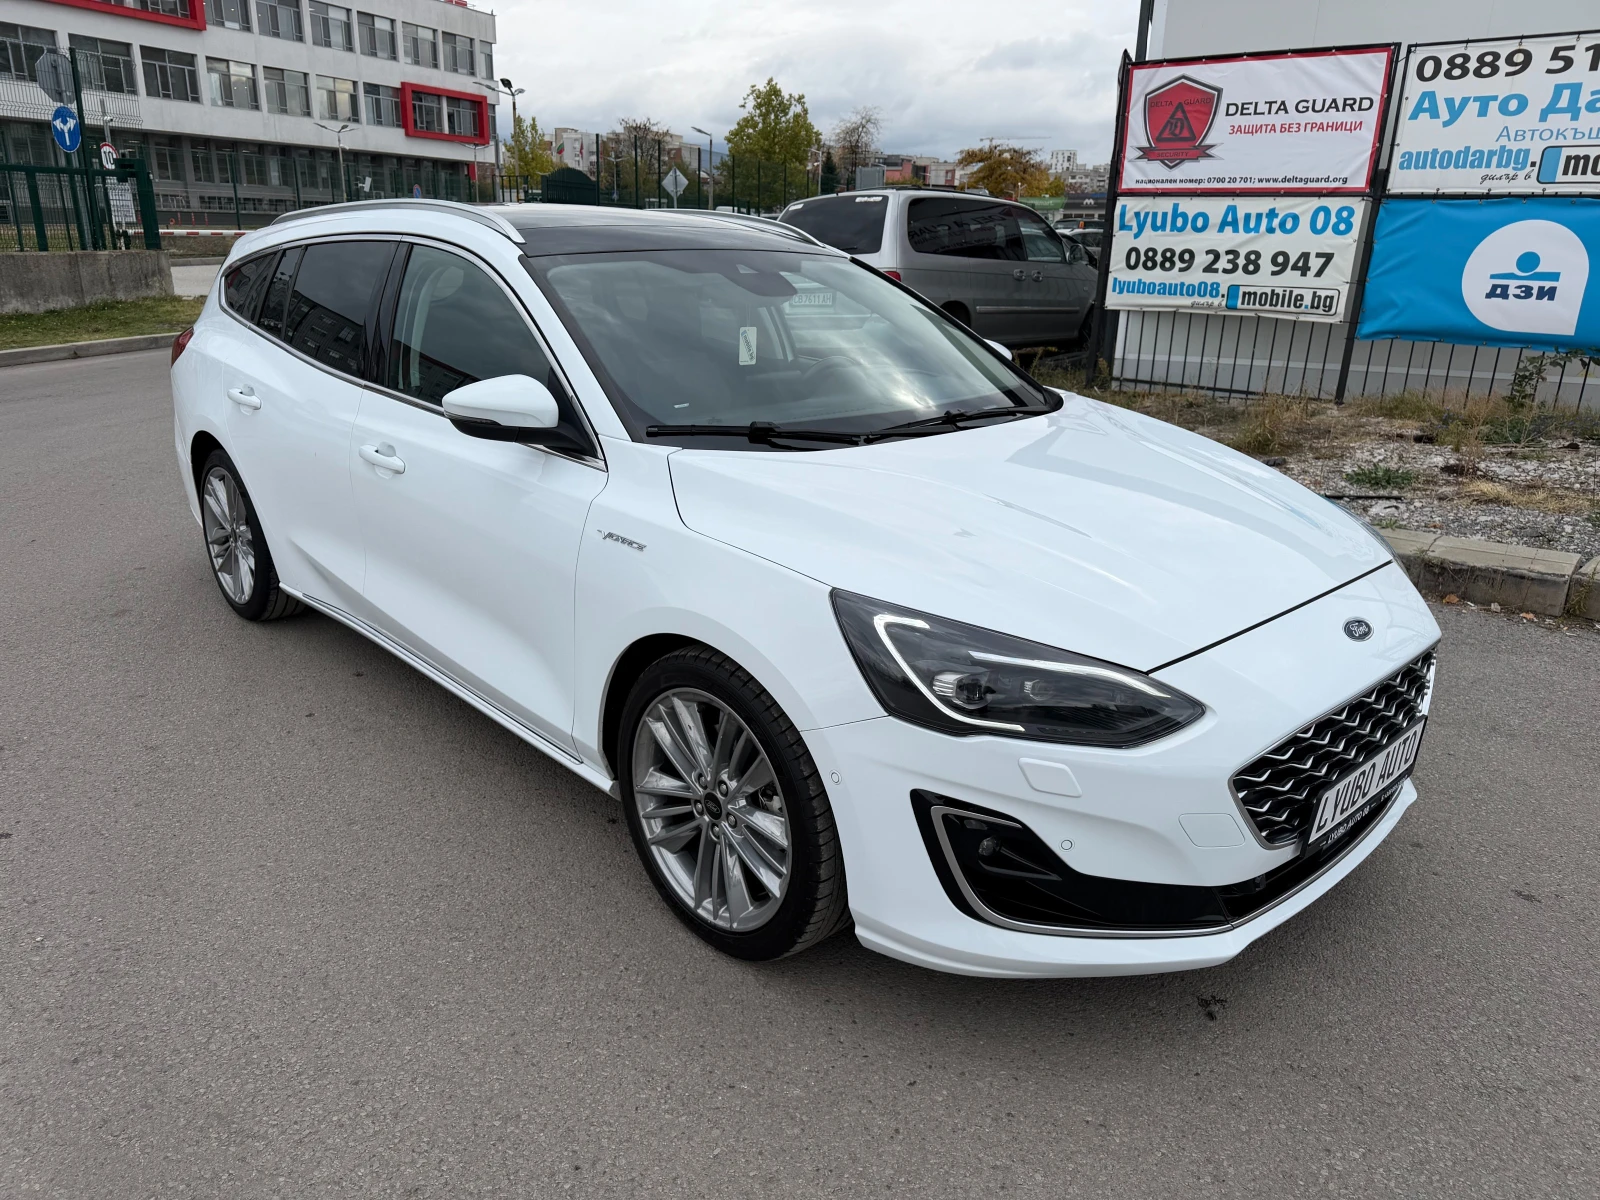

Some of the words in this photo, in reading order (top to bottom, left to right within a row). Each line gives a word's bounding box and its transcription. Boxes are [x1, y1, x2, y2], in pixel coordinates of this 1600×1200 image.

[1416, 48, 1533, 82] 0889
[1150, 100, 1173, 108] DELTA
[1183, 97, 1211, 106] GUARD
[1225, 100, 1289, 117] DELTA
[1294, 97, 1374, 114] GUARD
[1408, 90, 1529, 128] Ауто
[1228, 123, 1277, 136] ЗАЩИТА
[1279, 122, 1302, 133] БЕЗ
[1303, 121, 1363, 133] ГРАНИЦИ
[1206, 176, 1226, 184] 0700
[1238, 176, 1256, 185] 701;
[1257, 175, 1348, 185] www.deltaguard.org
[1119, 203, 1210, 240] Lyubo
[1217, 204, 1300, 235] Auto
[1309, 205, 1356, 236] 08
[1125, 246, 1196, 273] 0889
[1202, 249, 1262, 276] 238
[1270, 250, 1335, 278] 947
[1241, 289, 1335, 313] mobile.bg
[1485, 283, 1558, 301] ДЗИ
[1349, 622, 1369, 637] Ford
[1315, 761, 1376, 834] LYUBO
[1376, 729, 1417, 789] AUTO
